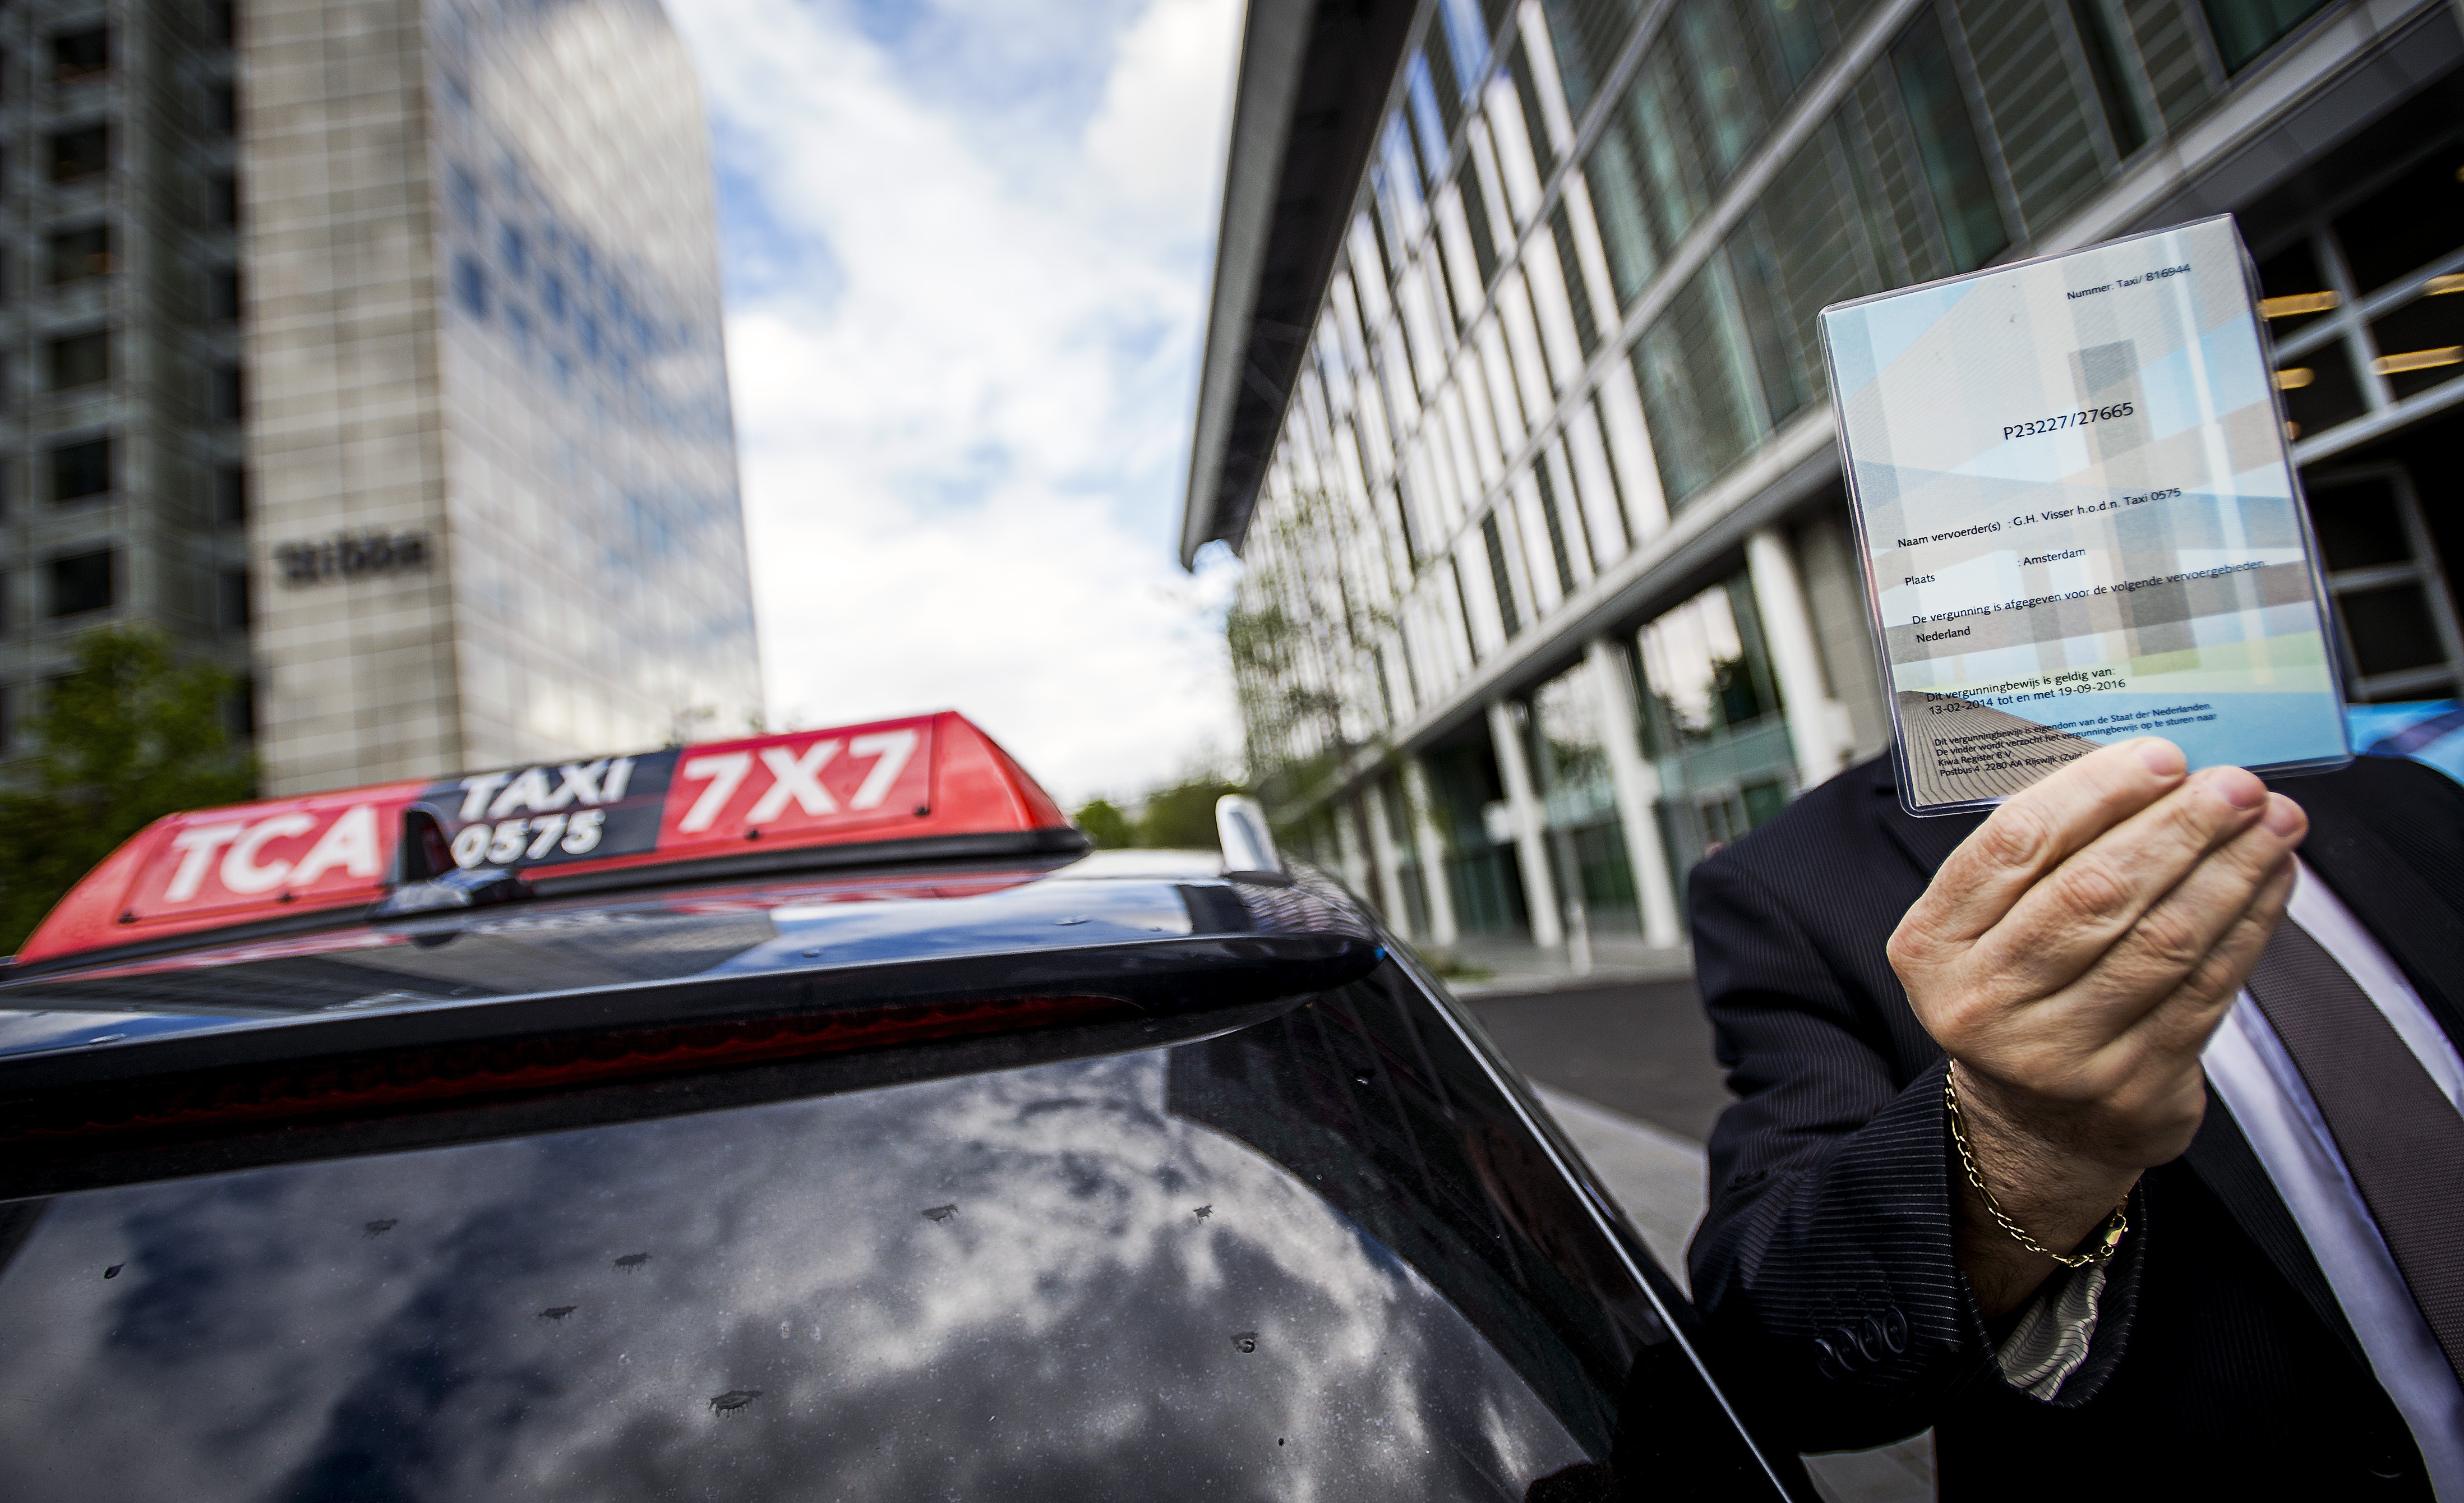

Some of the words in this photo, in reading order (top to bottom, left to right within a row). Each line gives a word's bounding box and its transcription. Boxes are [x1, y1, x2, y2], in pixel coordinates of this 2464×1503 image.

[2067, 284, 2114, 299] Nummer:
[2116, 275, 2142, 288] Taxi/
[2145, 264, 2191, 281] 816944
[2003, 402, 2134, 440] P23227/27665
[1898, 536, 1928, 547] Naam
[1931, 522, 2001, 541] vervoerder(s)
[2041, 508, 2074, 520] Visser
[2077, 500, 2121, 514] h.o.d.n.
[2123, 495, 2148, 506] Taxi
[2151, 488, 2181, 501] 0575
[1904, 574, 1935, 585] Plaats
[2023, 548, 2086, 566] Amsterdam
[1912, 615, 1927, 625] De
[1930, 605, 1991, 621] vergunning
[1994, 602, 2001, 611] is
[2005, 594, 2062, 610] afgegeven
[2065, 589, 2091, 600] voor
[2093, 586, 2107, 595] de
[2111, 575, 2163, 592] volgende
[2166, 560, 2269, 583] vervoergebieden:
[1916, 626, 1971, 643] Nederland
[1926, 693, 1943, 702] Dit
[1945, 678, 2040, 699] vergunningbewijs
[2043, 676, 2051, 685] is
[2055, 671, 2089, 685] geldig
[2092, 668, 2116, 678] van:
[1929, 698, 1994, 715] 13-02-2014
[1997, 695, 2014, 706] tot
[2017, 694, 2030, 703] en
[2033, 689, 2056, 700] met
[2058, 679, 2126, 697] 19-09-2016
[1935, 738, 1948, 746] Dit
[1949, 729, 2023, 744] vergunningbewijs
[2034, 722, 2077, 734] eigendom
[2111, 713, 2134, 722] Staat
[2152, 703, 2213, 717] Nederlanden.
[1950, 745, 1977, 754] vinder
[1978, 741, 2005, 750] wordt
[2006, 736, 2043, 747] verzocht
[2046, 734, 2060, 742] het
[2062, 723, 2138, 740] vergunningbewijs
[2166, 717, 2194, 726] sturen
[2197, 713, 2217, 722] naar
[1938, 758, 1959, 767] Kiwa
[1961, 753, 1995, 764] Register
[1940, 767, 1972, 777] Postbus
[1985, 762, 2008, 771] 2280
[2026, 755, 2058, 766] Rijswijk
[459, 757, 636, 822] TAXI
[677, 729, 919, 834] 7X7
[164, 803, 382, 902] TCA
[450, 809, 606, 869] 0575
